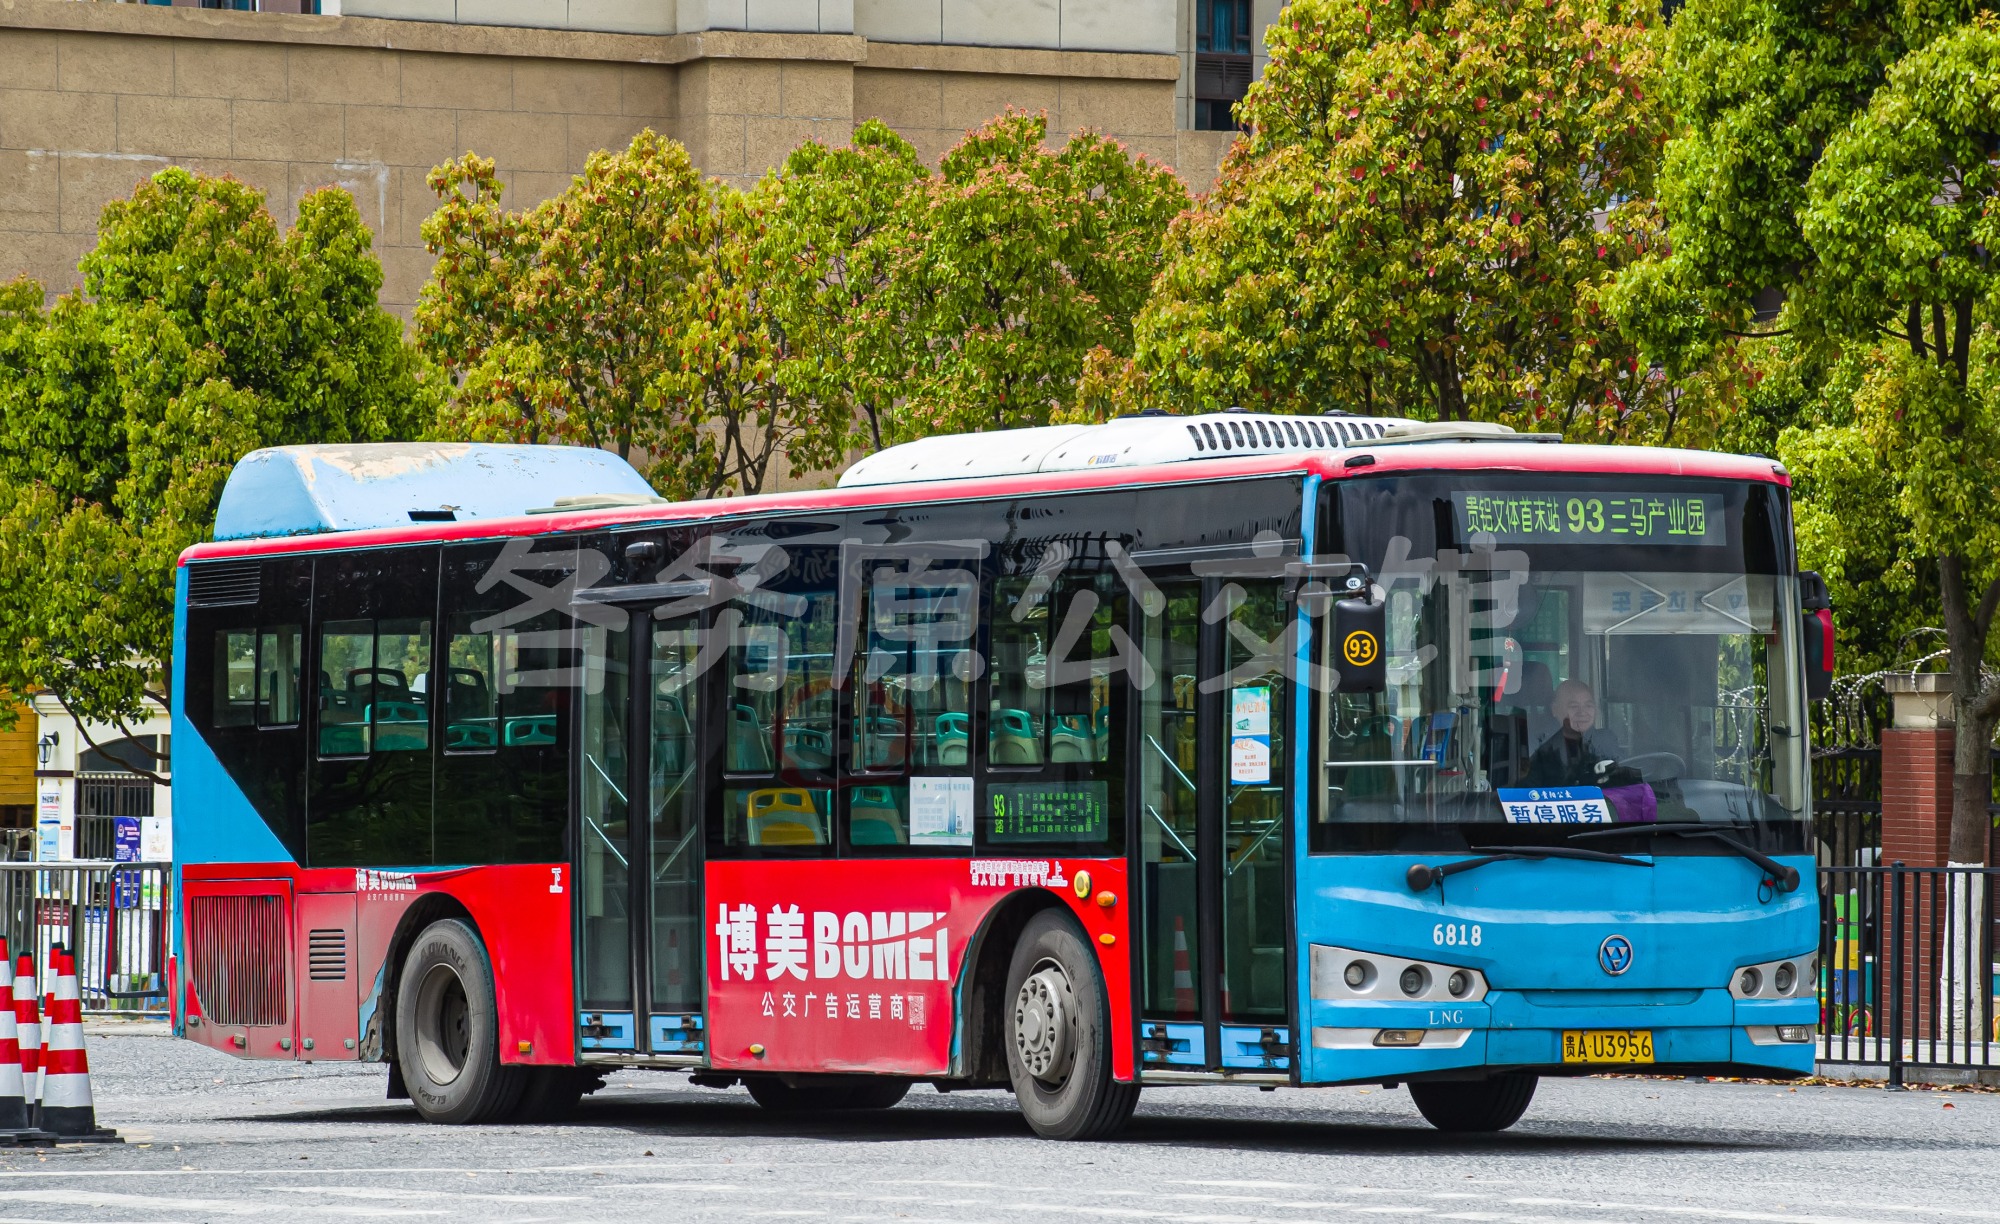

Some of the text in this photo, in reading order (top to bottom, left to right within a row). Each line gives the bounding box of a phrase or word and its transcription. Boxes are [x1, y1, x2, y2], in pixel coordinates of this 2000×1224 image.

[1465, 494, 1706, 536] 贵铝文体首末站 93 三马产业园
[1349, 638, 1373, 659] 93
[1509, 803, 1603, 823] 暂停服务
[1432, 922, 1482, 947] 6818
[761, 990, 904, 1021] 公交广告运营商
[1429, 1009, 1464, 1025] LNG
